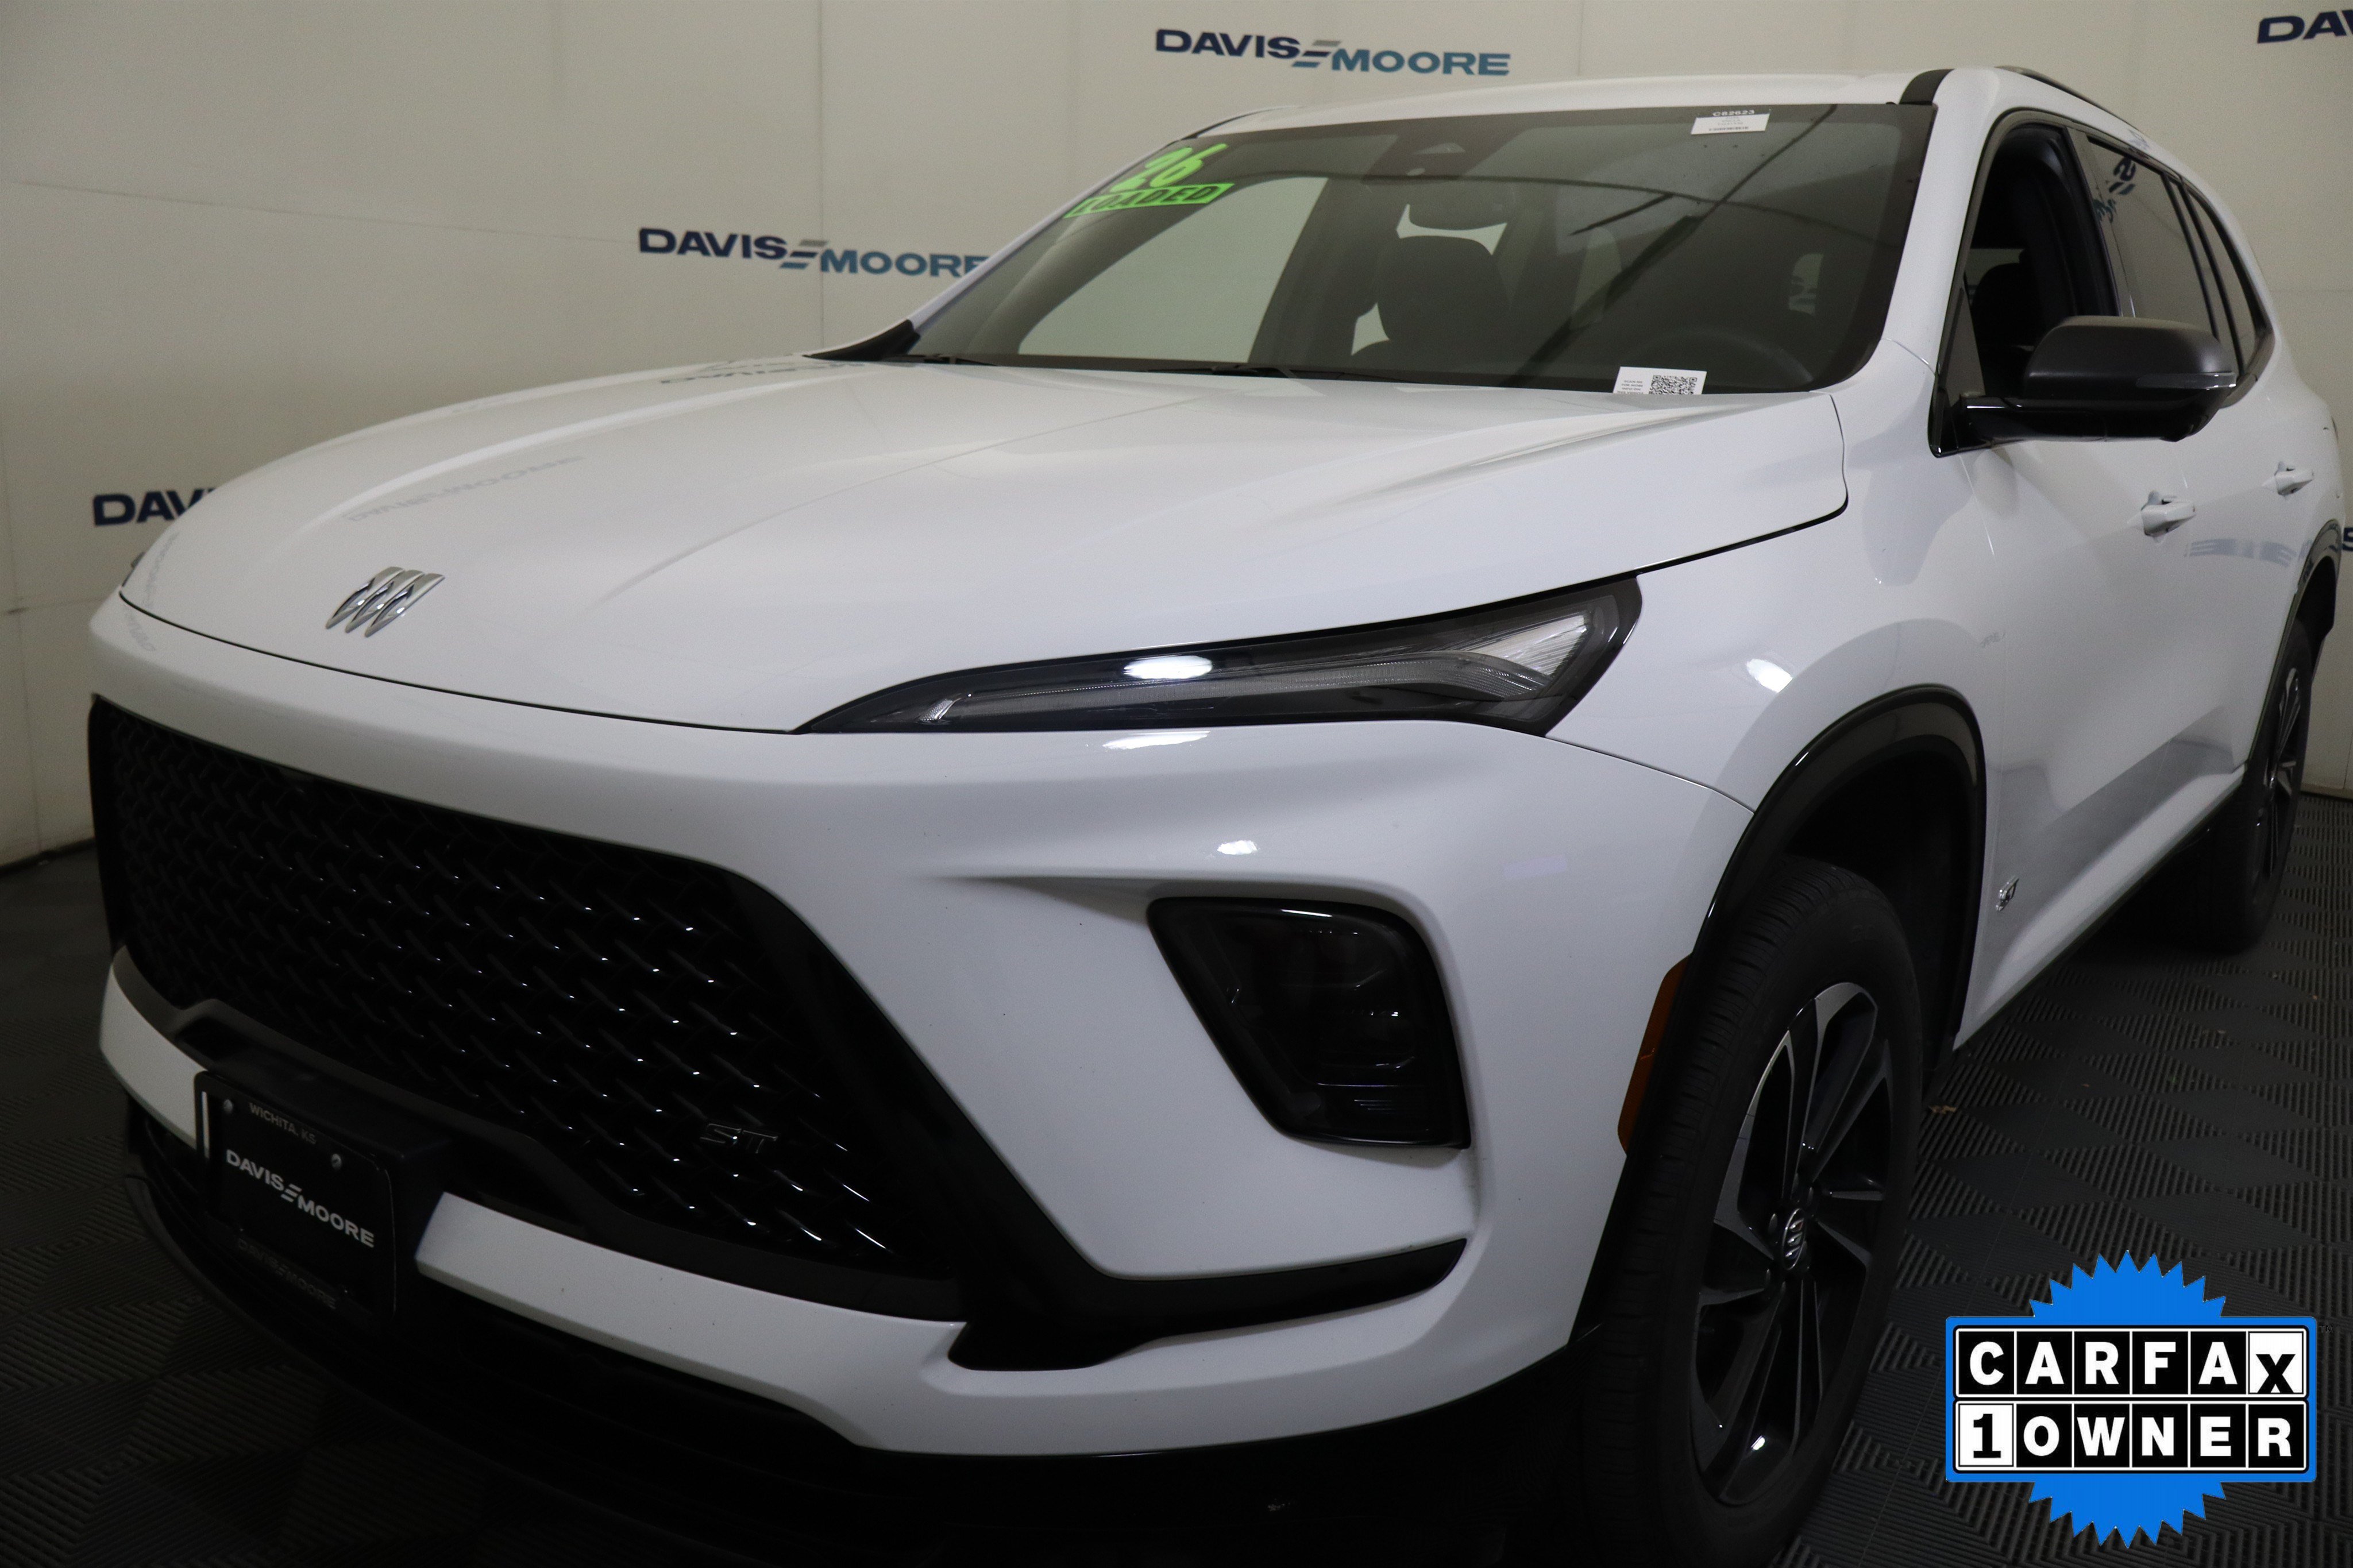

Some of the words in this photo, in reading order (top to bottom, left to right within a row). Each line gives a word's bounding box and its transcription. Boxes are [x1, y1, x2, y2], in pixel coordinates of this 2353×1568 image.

[2257, 9, 2353, 44] DA
[1155, 29, 1301, 58] DAVIS
[1331, 48, 1511, 76] MOORE
[1109, 143, 1228, 192] 26
[1073, 186, 1219, 215] LOADED
[639, 227, 788, 260] DAVIS
[94, 488, 216, 526] DAV
[249, 1102, 299, 1137] WICHITA,
[301, 1129, 317, 1145] KS
[226, 1149, 285, 1191] DAVIS
[296, 1194, 375, 1248] MOORE
